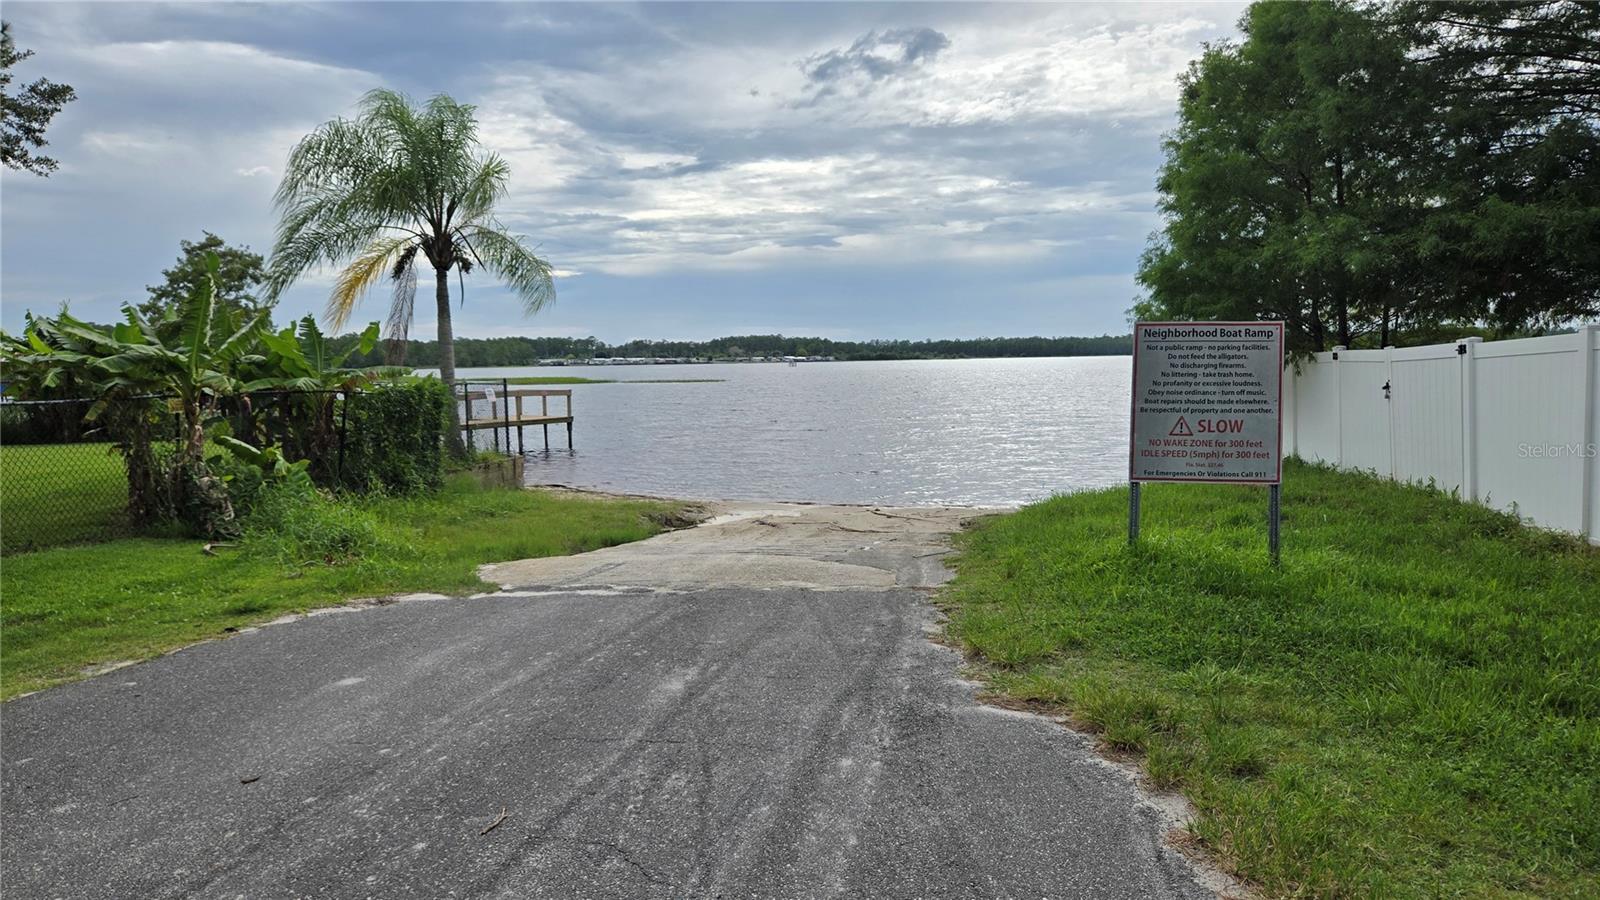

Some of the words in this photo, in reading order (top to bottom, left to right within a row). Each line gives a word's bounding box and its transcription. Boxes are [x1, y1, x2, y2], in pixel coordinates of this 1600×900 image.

[1144, 328, 1217, 339] Neighborhood
[1220, 328, 1242, 337] Boat
[1245, 328, 1273, 339] Ramp
[1198, 419, 1244, 433] SLOW
[1190, 450, 1220, 460] (5mph)
[1156, 470, 1196, 478] Emergencies
